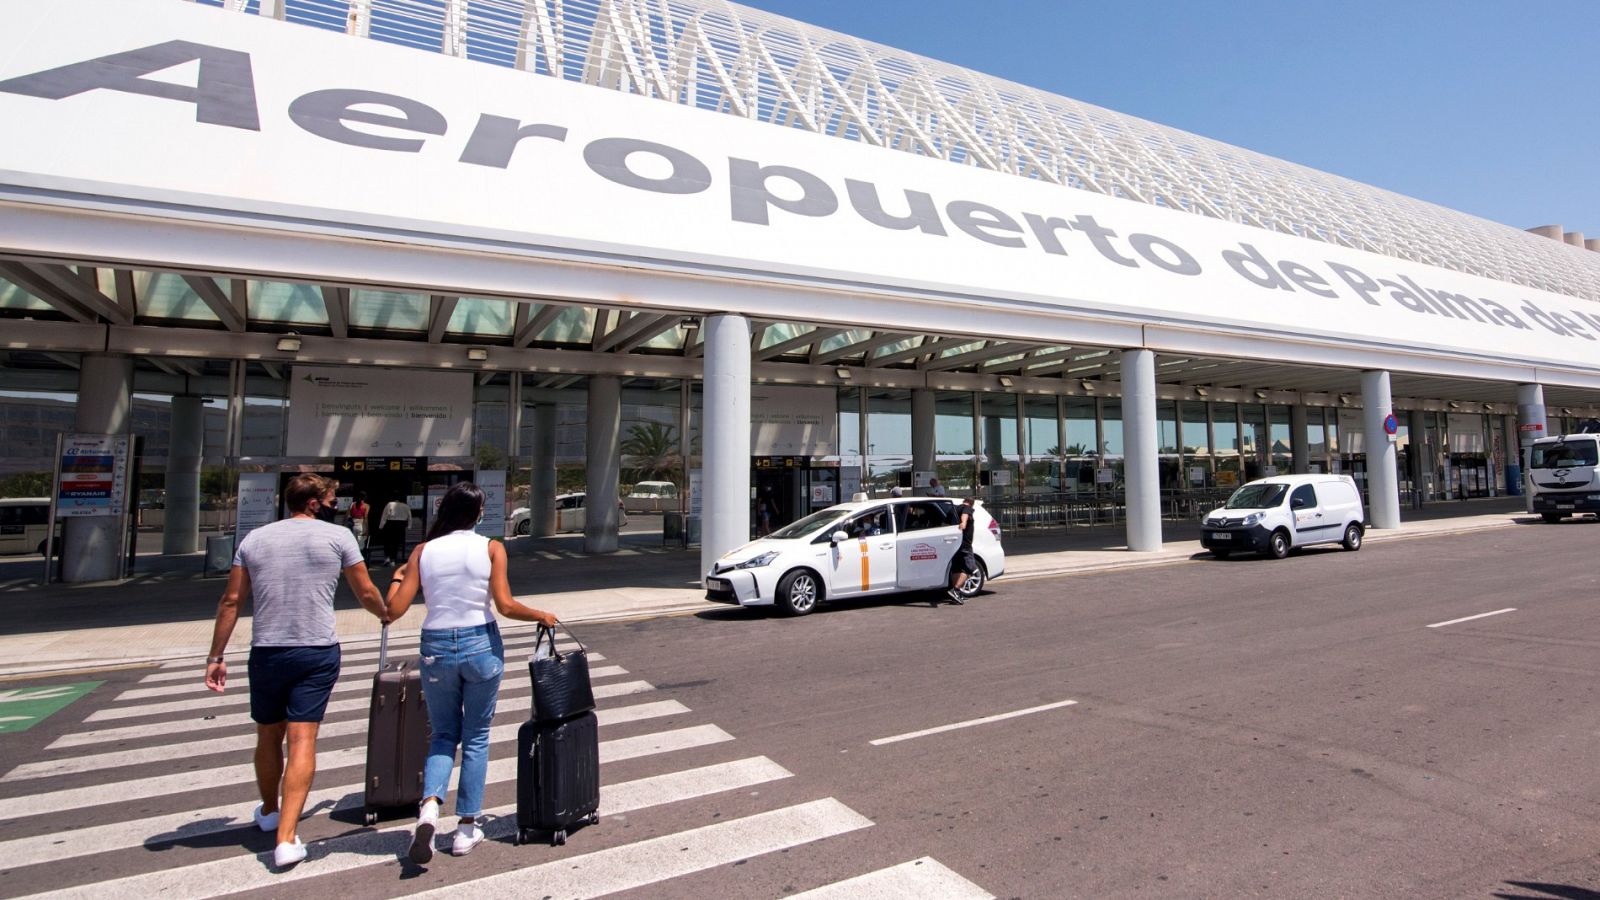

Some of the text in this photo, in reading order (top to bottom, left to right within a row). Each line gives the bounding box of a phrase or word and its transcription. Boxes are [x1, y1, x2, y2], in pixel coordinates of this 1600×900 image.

[0, 40, 1597, 341] Aeropuerto de Palma de
